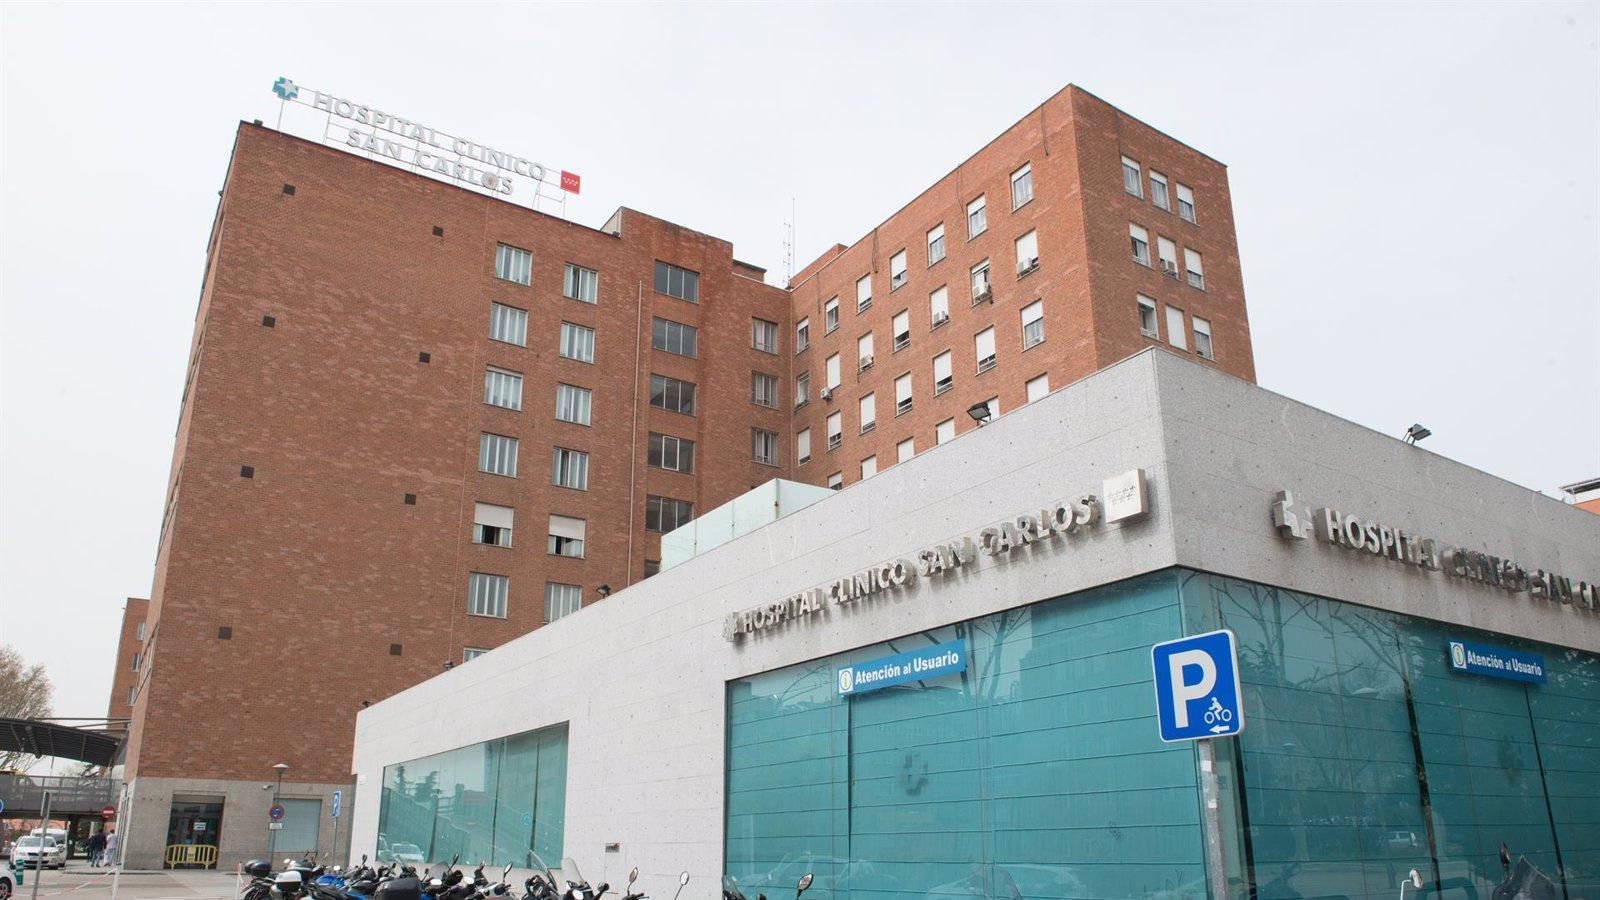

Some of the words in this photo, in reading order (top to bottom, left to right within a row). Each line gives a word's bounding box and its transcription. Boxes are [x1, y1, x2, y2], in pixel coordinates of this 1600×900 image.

[313, 91, 440, 148] HOSPITAL
[453, 138, 546, 181] CLINICO
[346, 128, 402, 161] SAN
[415, 150, 514, 196] CARLOS
[742, 588, 825, 633] HOSPITAL
[831, 559, 911, 605] CLINICO
[918, 537, 974, 577] SAN
[979, 495, 1098, 556] CARLOS
[1317, 507, 1442, 571] HOSPITAL
[855, 663, 901, 686] Atención
[903, 662, 912, 676] al
[913, 650, 960, 673] Usuario
[1168, 649, 1217, 729] P
[1467, 650, 1504, 670] Atención
[1505, 658, 1512, 671] al
[1511, 658, 1543, 677] Usuario
